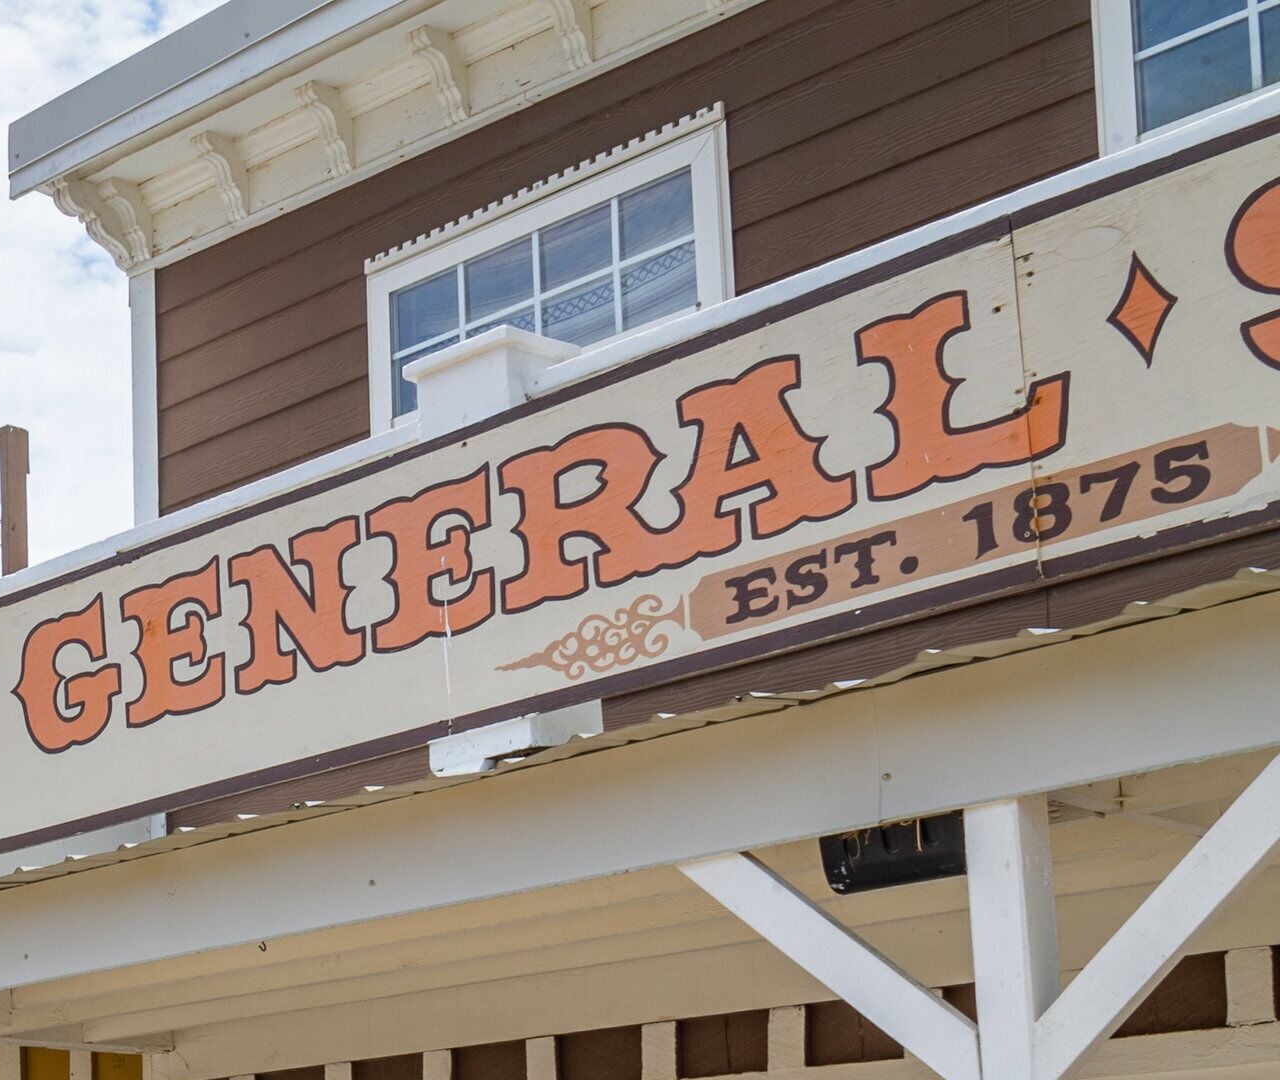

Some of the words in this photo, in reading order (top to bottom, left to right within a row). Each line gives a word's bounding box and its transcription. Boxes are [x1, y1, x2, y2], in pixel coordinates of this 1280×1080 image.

[12, 290, 1071, 754] GENERAL
[725, 531, 920, 625] EST.
[962, 440, 1212, 560] 1875
